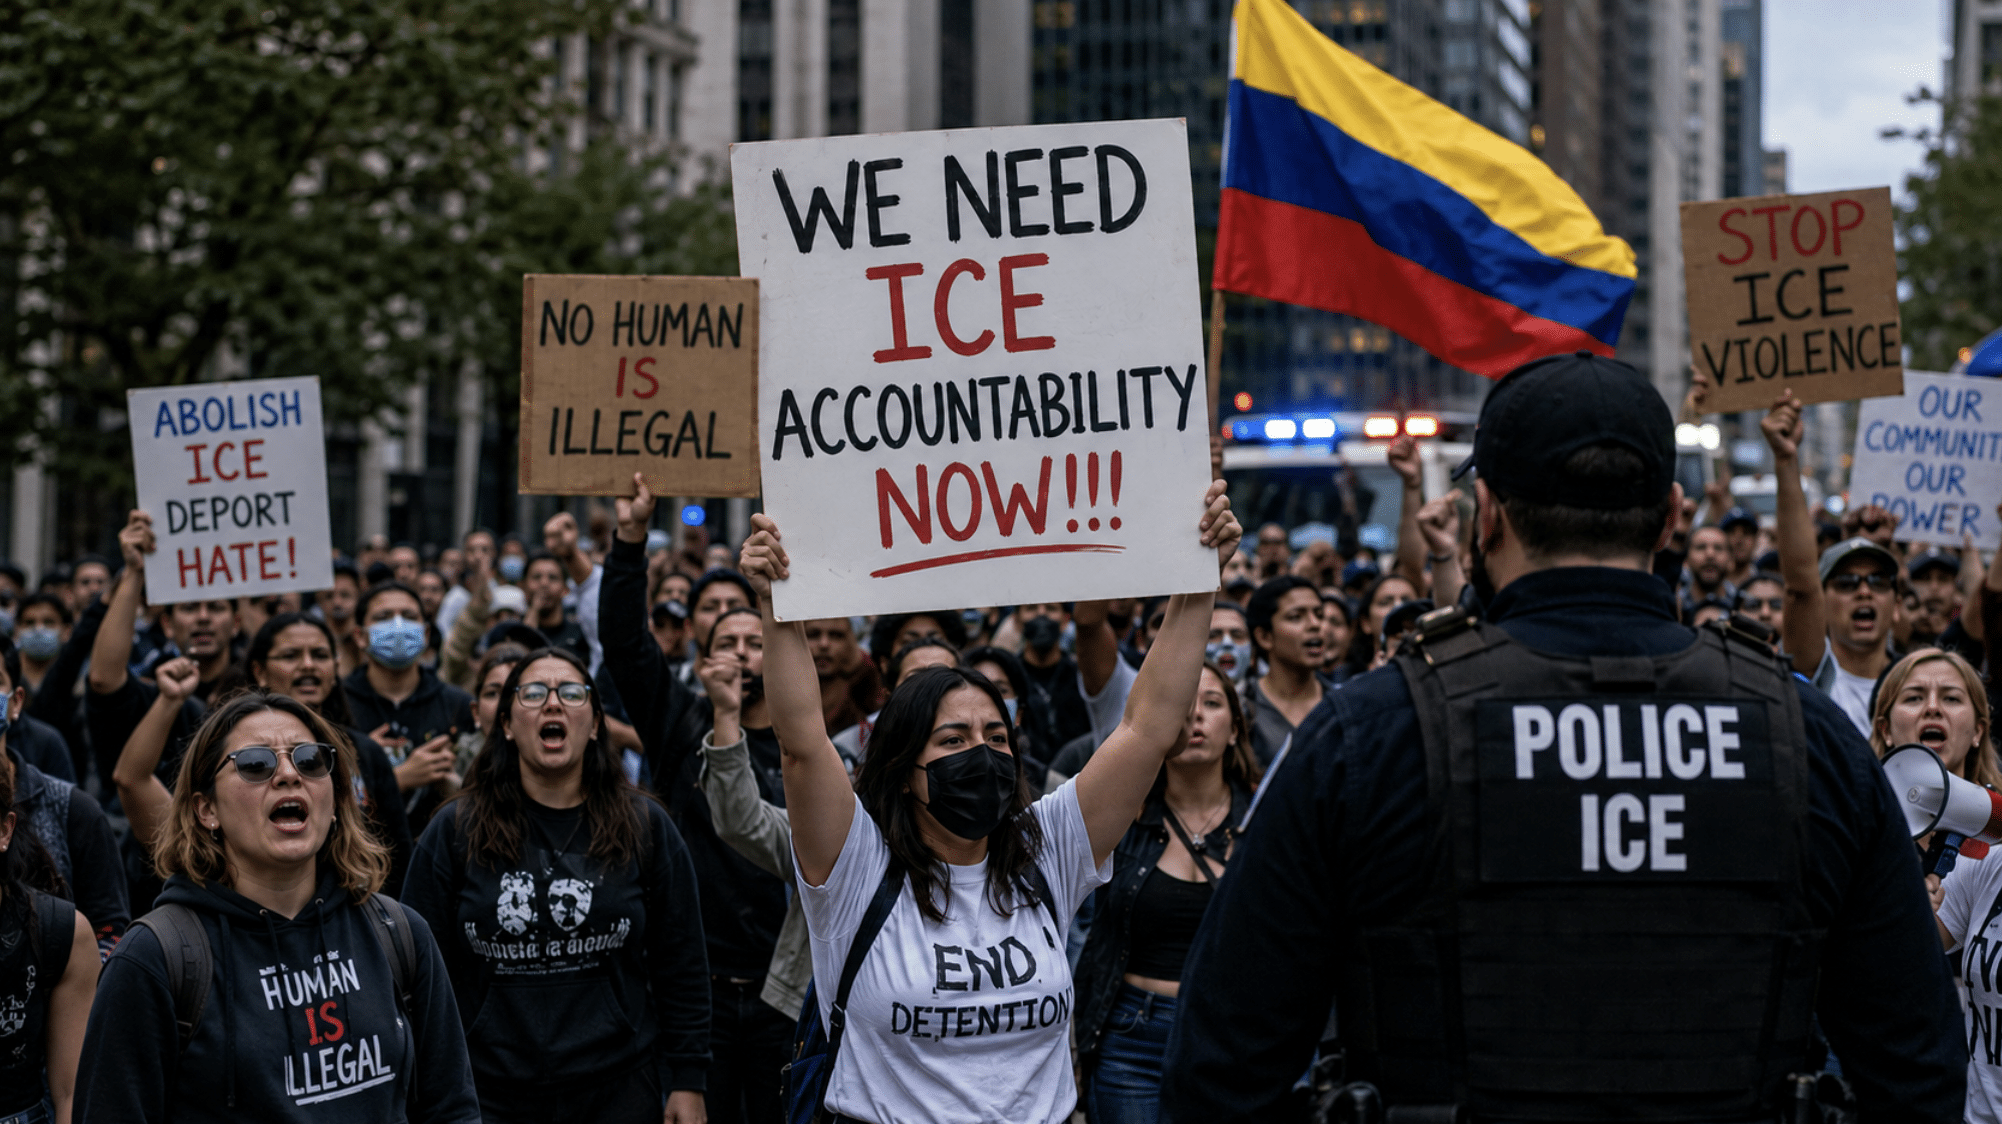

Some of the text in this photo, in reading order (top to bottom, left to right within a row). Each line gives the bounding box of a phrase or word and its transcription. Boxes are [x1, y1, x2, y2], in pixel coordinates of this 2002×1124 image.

[772, 145, 1147, 254] WE NEED
[1718, 200, 1864, 265] STOP
[866, 254, 1056, 363] ICE
[1733, 264, 1854, 326] ICE
[540, 299, 743, 349] NO HUMAN
[615, 356, 659, 399] IS
[1702, 322, 1900, 387] VIOLENCE
[154, 389, 302, 438] ABOLISH
[772, 364, 1197, 460] ACCOUNTABILITY
[1919, 384, 1983, 423] OUR
[549, 406, 732, 459] ILLEGAL
[1864, 418, 2002, 462] COMMUNIT
[184, 438, 269, 485] ICE
[1904, 460, 1967, 498] OUR
[166, 491, 296, 535] DEPORT
[875, 449, 1122, 549] NOW!!!
[177, 537, 297, 588] HATE!
[1512, 703, 1746, 780] POLICE
[1580, 792, 1688, 872] ICE
[260, 958, 361, 1011] HUMAN
[305, 1000, 345, 1046] IS
